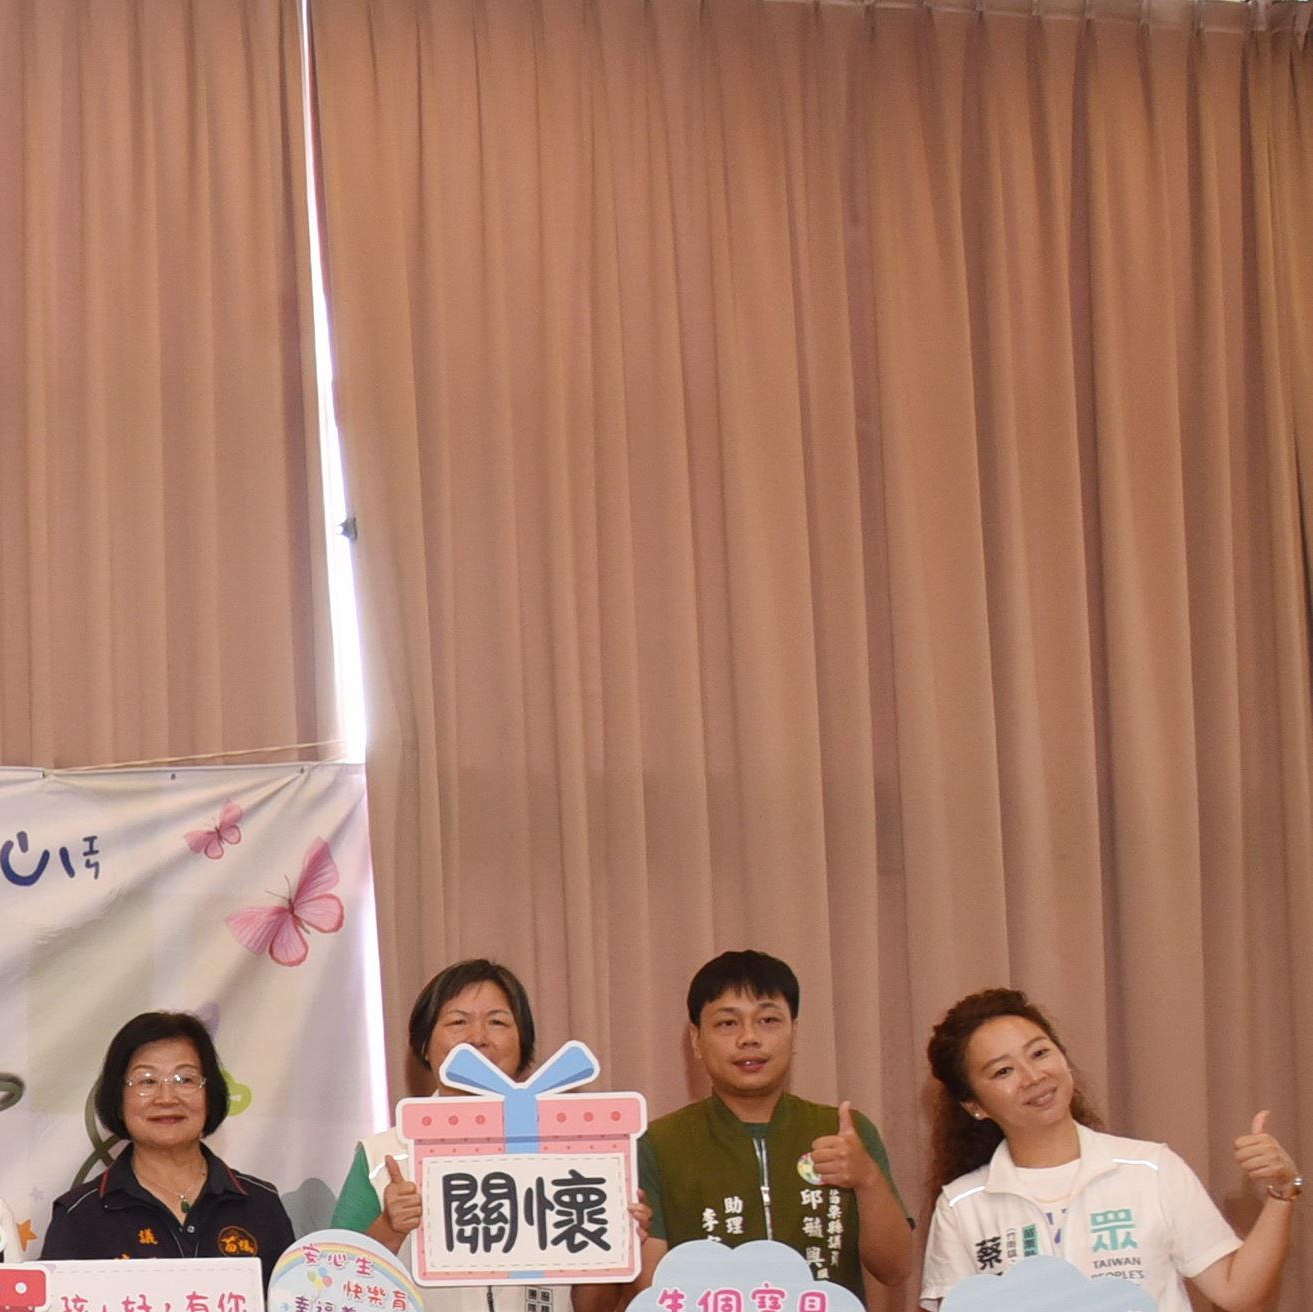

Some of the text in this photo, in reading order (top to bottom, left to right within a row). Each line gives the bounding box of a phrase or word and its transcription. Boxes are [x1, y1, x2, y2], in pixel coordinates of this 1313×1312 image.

[442, 1169, 611, 1256] 關懷
[723, 1196, 744, 1235] 助理
[302, 1243, 374, 1276] 安心生
[1092, 1257, 1142, 1270] TAIWAN
